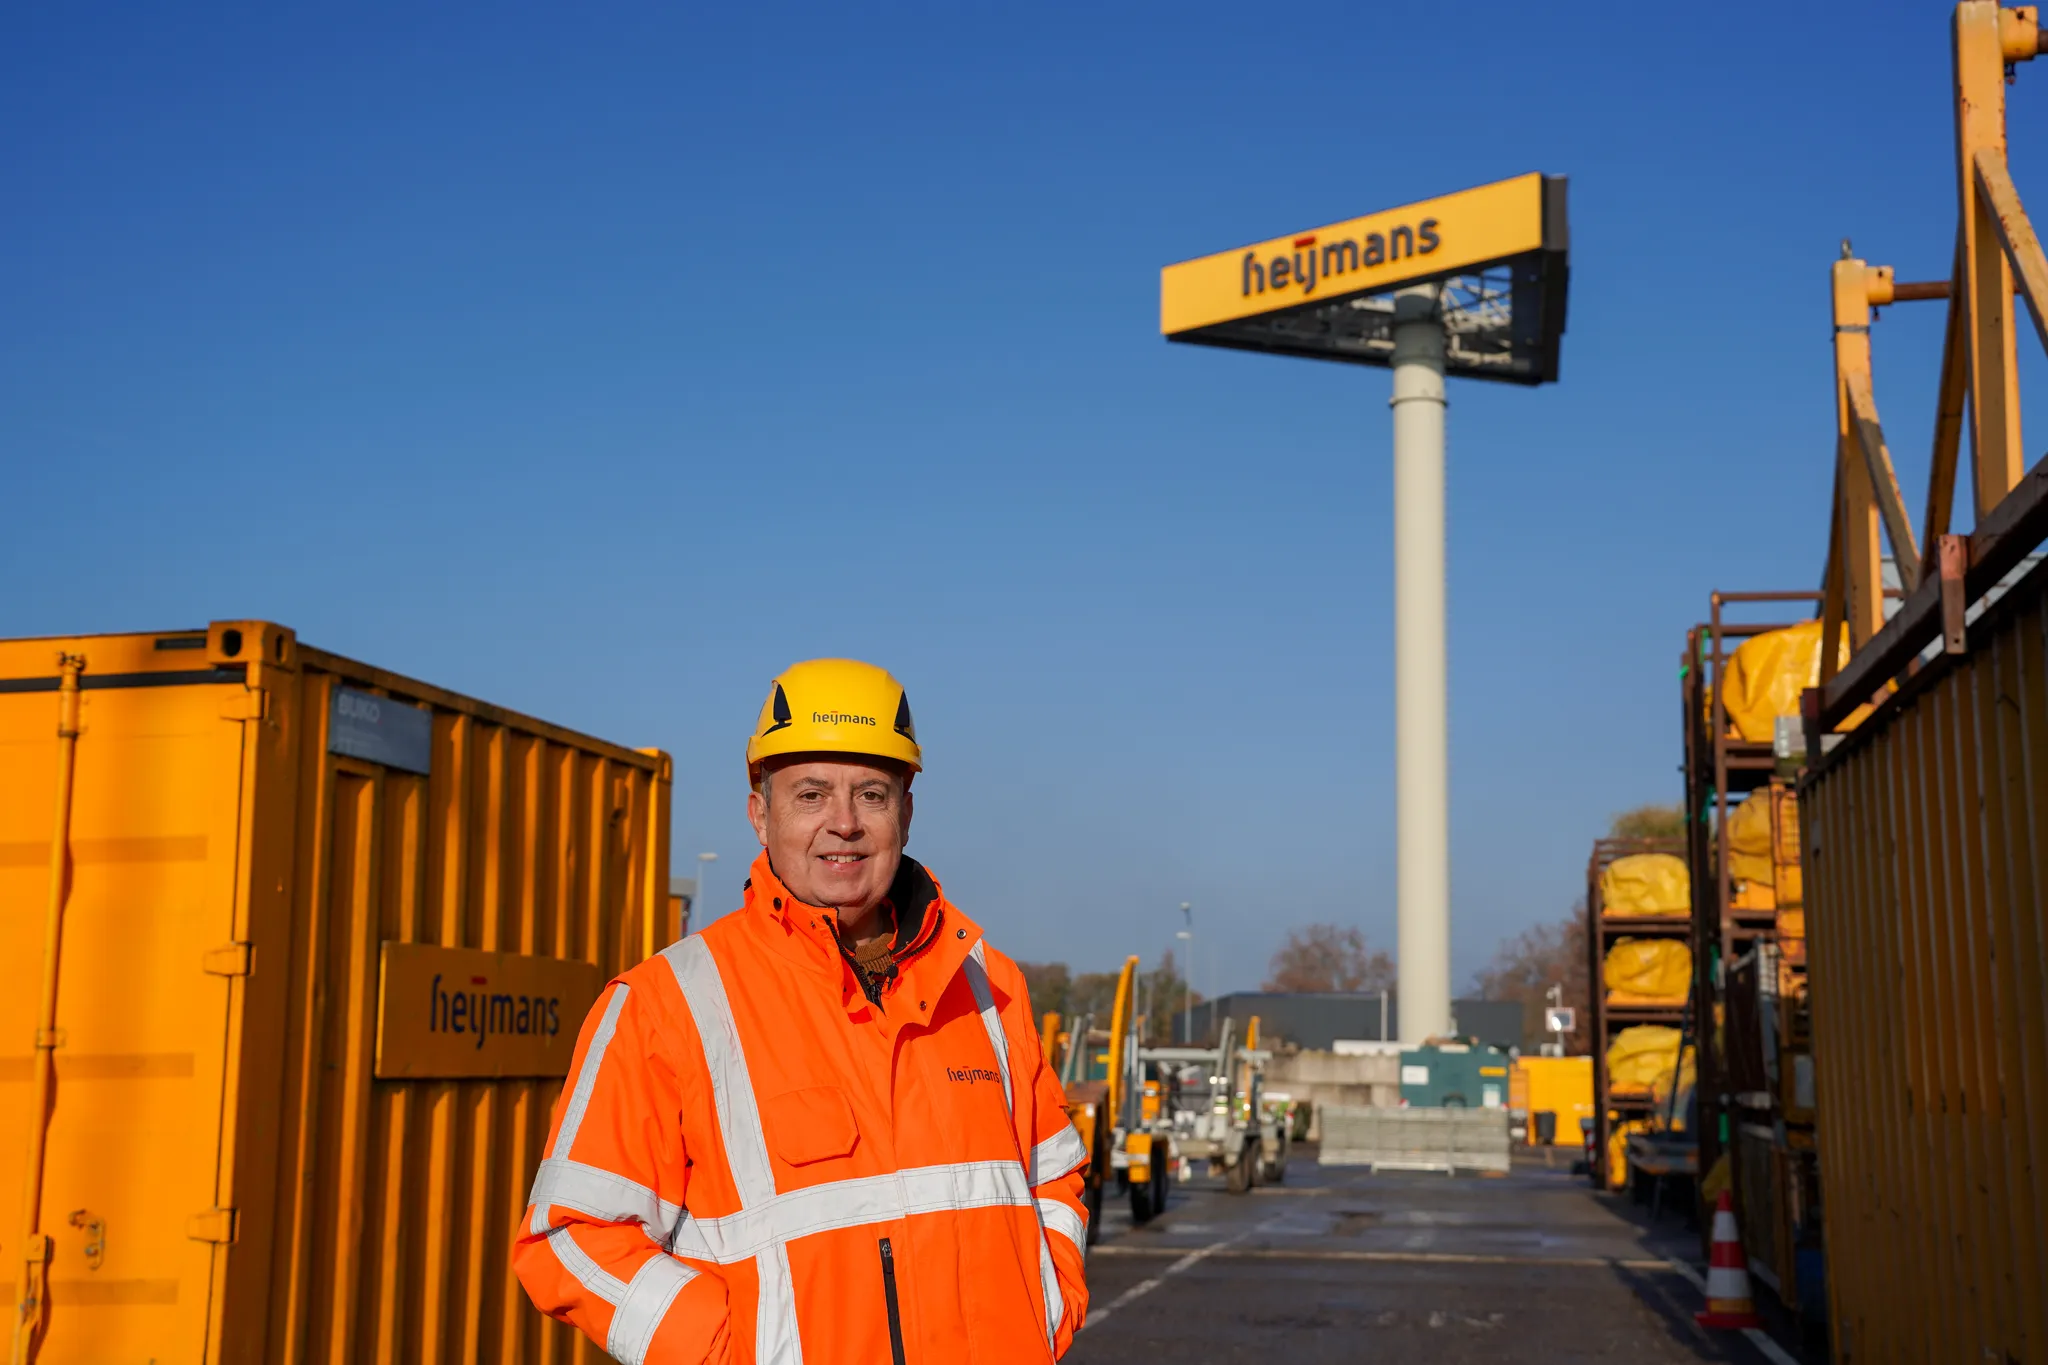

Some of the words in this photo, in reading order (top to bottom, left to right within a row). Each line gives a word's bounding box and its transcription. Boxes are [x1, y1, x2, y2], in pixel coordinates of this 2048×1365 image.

[1242, 217, 1441, 297] heijmans
[812, 710, 876, 726] heijmans
[430, 973, 560, 1050] heijmans
[946, 1065, 1000, 1085] heijmans
